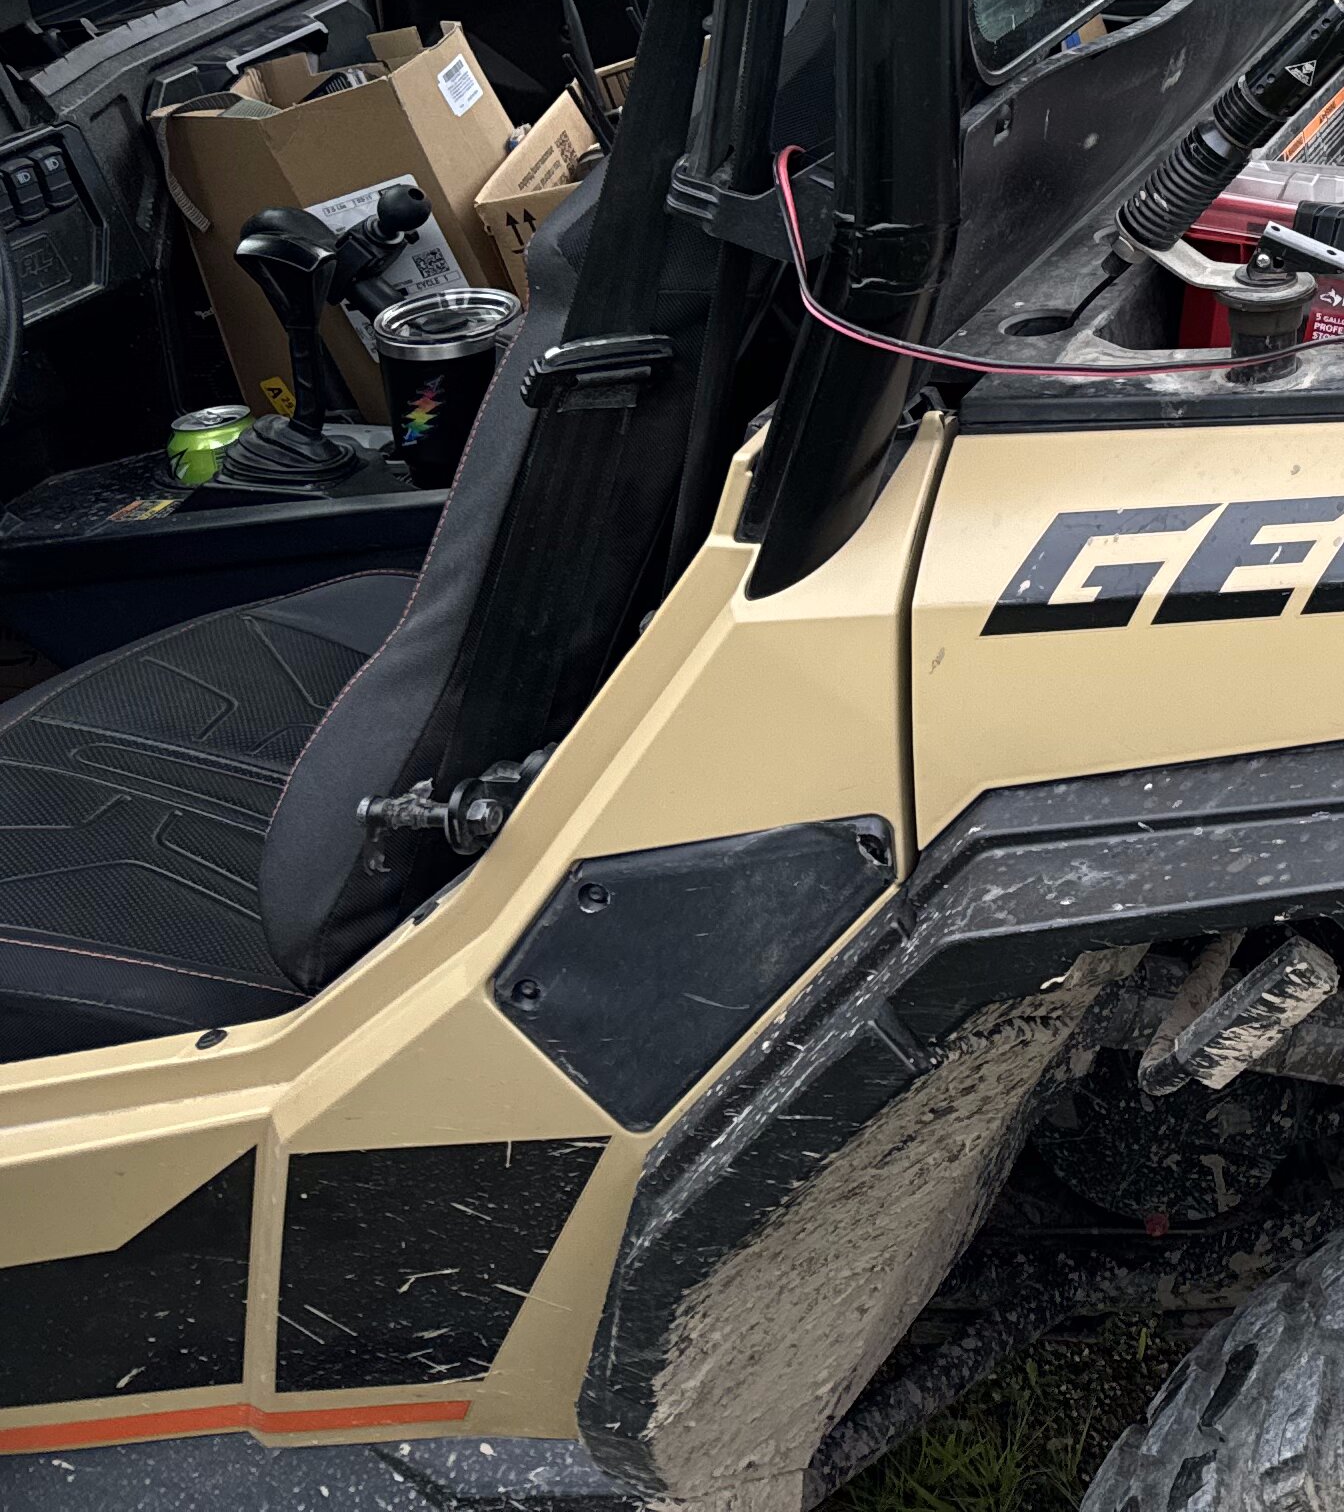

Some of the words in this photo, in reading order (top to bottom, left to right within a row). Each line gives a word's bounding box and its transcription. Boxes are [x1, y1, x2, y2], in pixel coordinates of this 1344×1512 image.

[415, 277, 440, 290] CYCLE
[1315, 312, 1322, 321] 5
[267, 387, 283, 399] A
